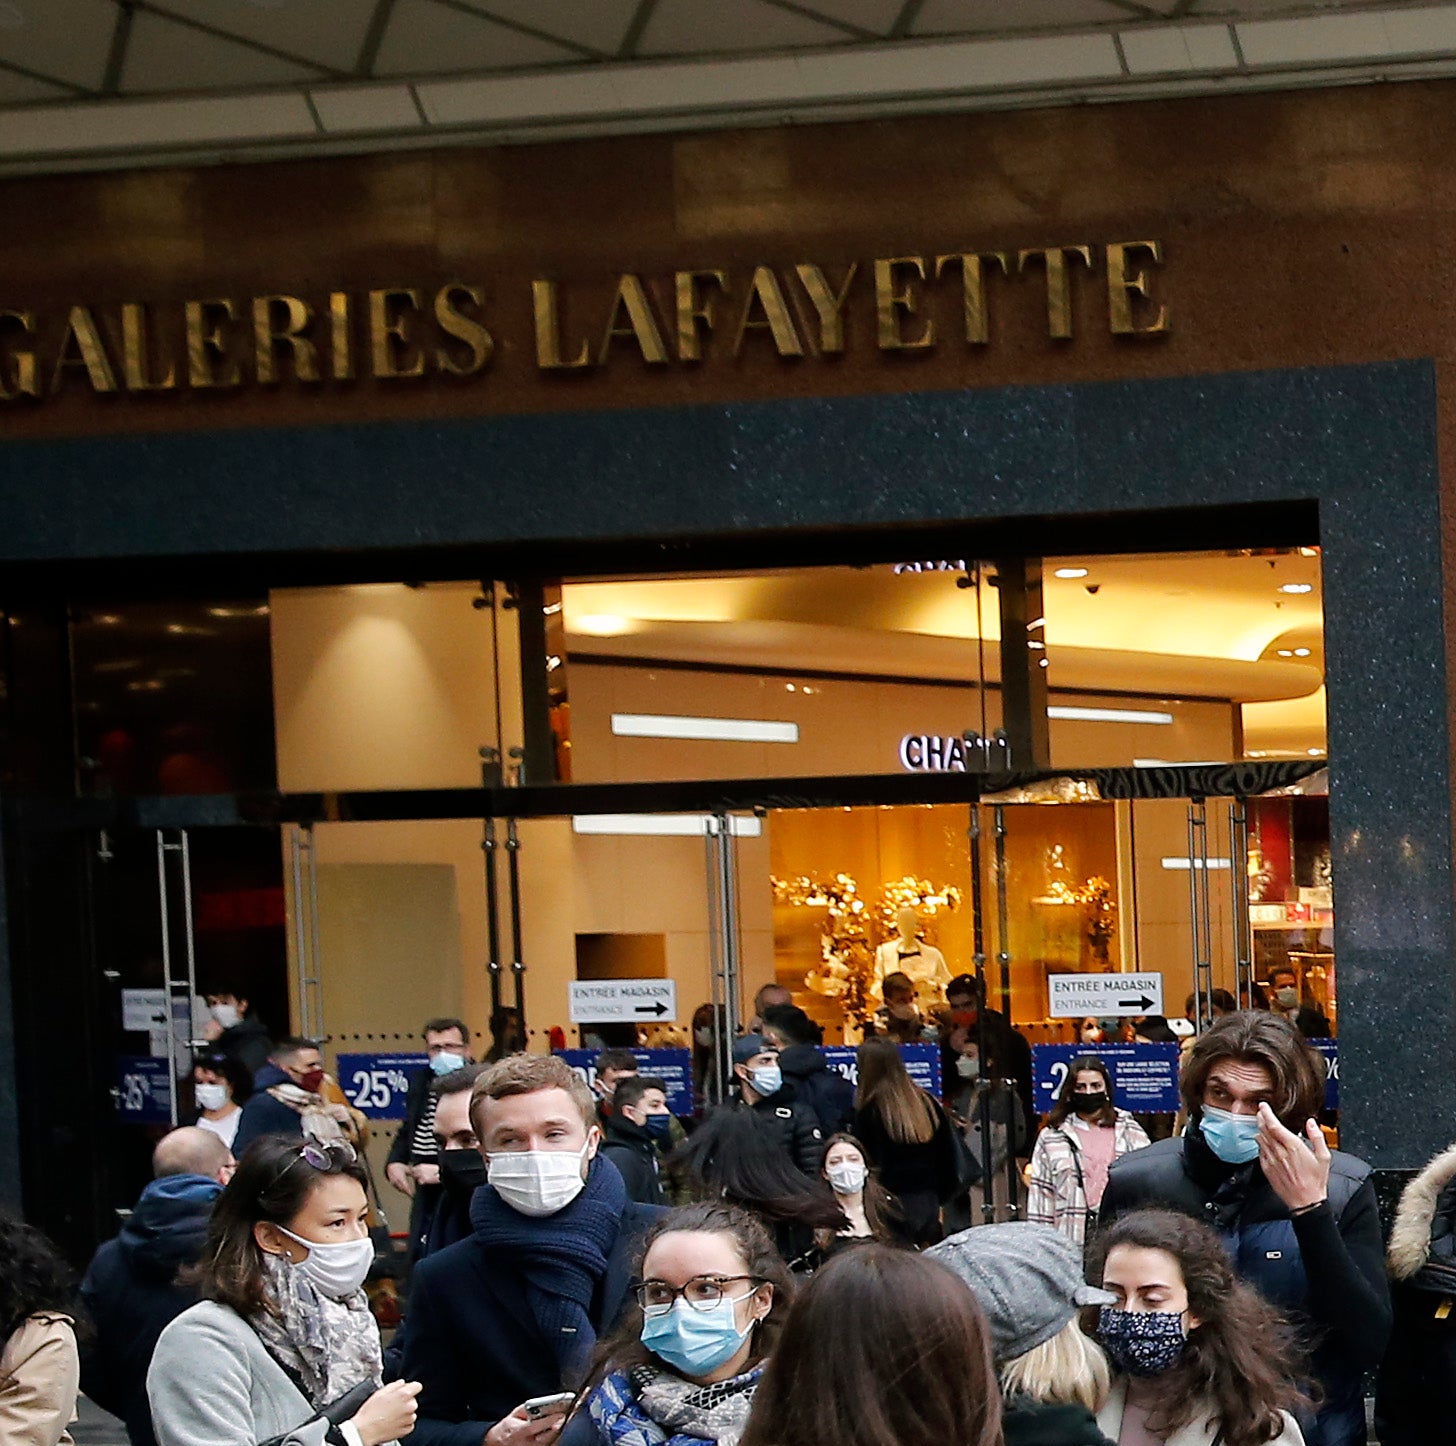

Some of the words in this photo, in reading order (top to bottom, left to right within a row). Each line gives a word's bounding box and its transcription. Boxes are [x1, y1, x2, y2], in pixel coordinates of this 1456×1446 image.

[0, 282, 495, 399] GALERIES
[531, 240, 1171, 370] LAFAYETTE
[1054, 980, 1100, 993] ENTRÉE
[1103, 980, 1157, 991] MAGASIN
[1055, 999, 1108, 1010] ENTRANCE
[345, 1068, 409, 1110] -25%
